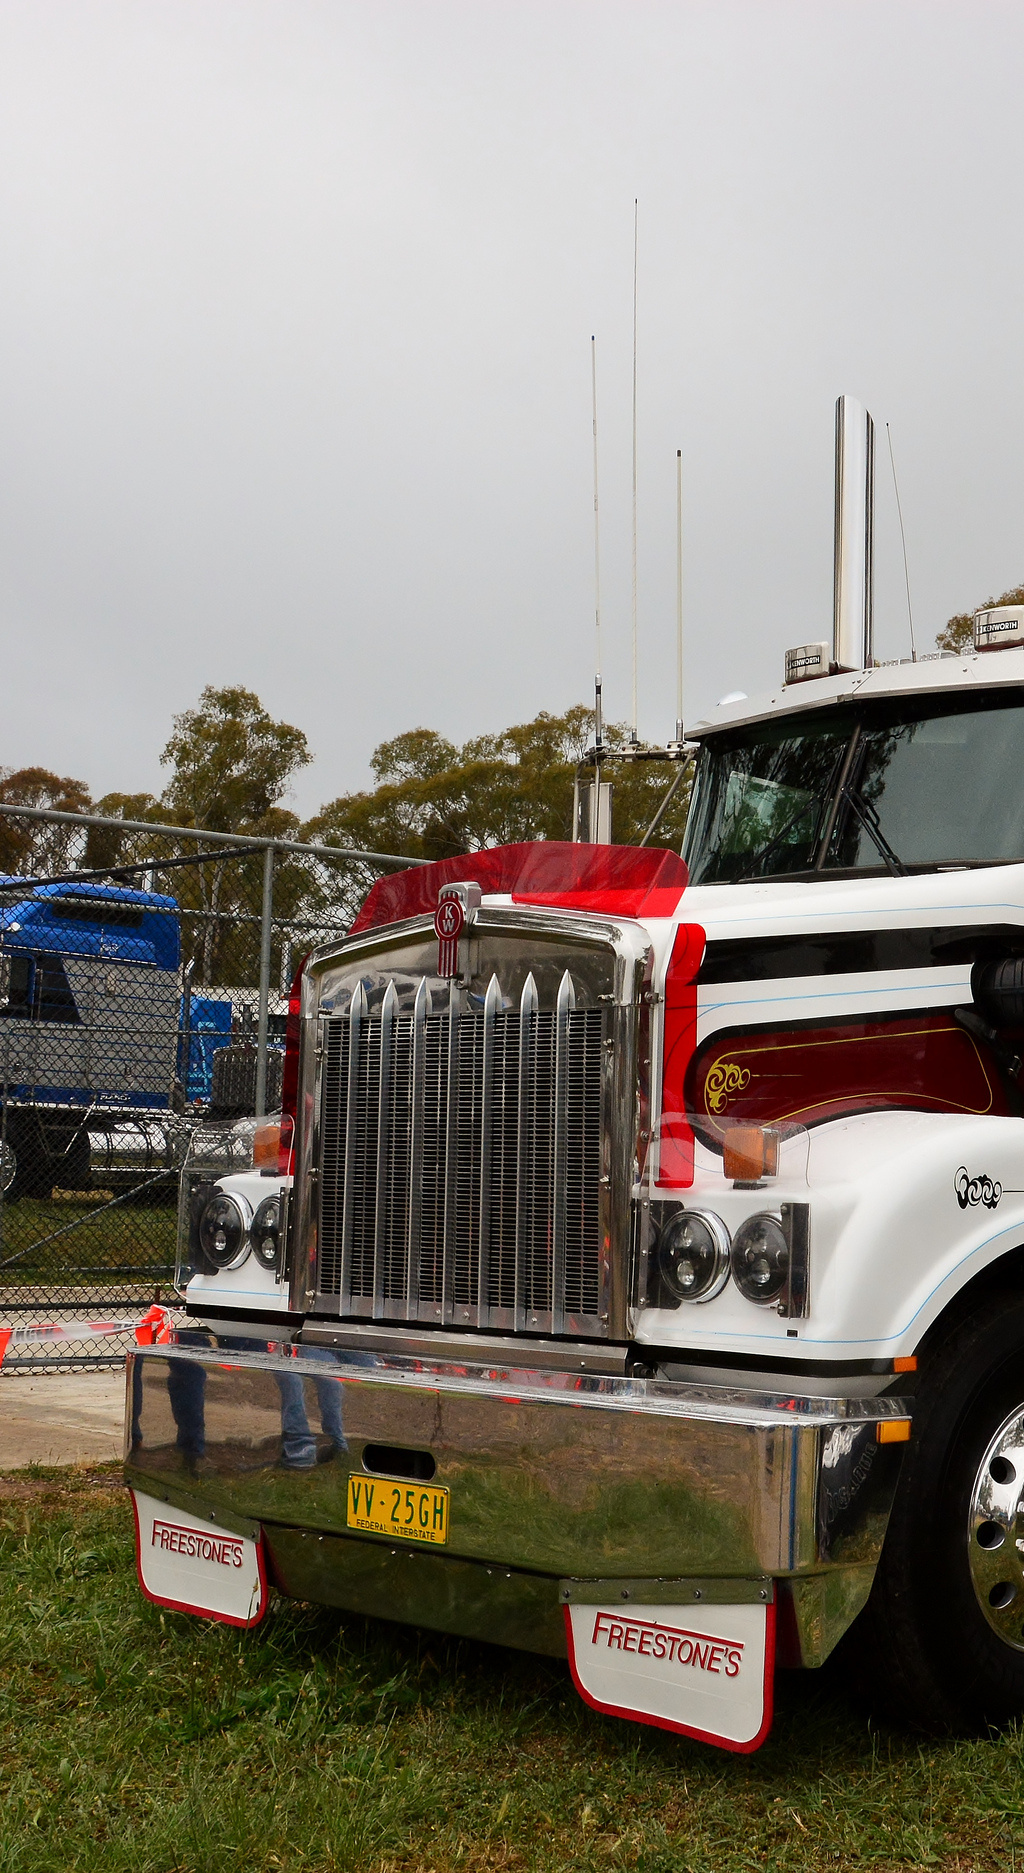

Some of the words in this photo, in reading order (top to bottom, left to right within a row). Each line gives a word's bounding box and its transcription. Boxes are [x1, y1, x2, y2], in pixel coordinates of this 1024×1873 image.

[151, 1519, 244, 1568] FREESTONE'S
[356, 1518, 389, 1533] FEDERAL
[392, 1525, 436, 1541] INTERSTATE
[591, 1611, 745, 1677] FREESTONE'S
